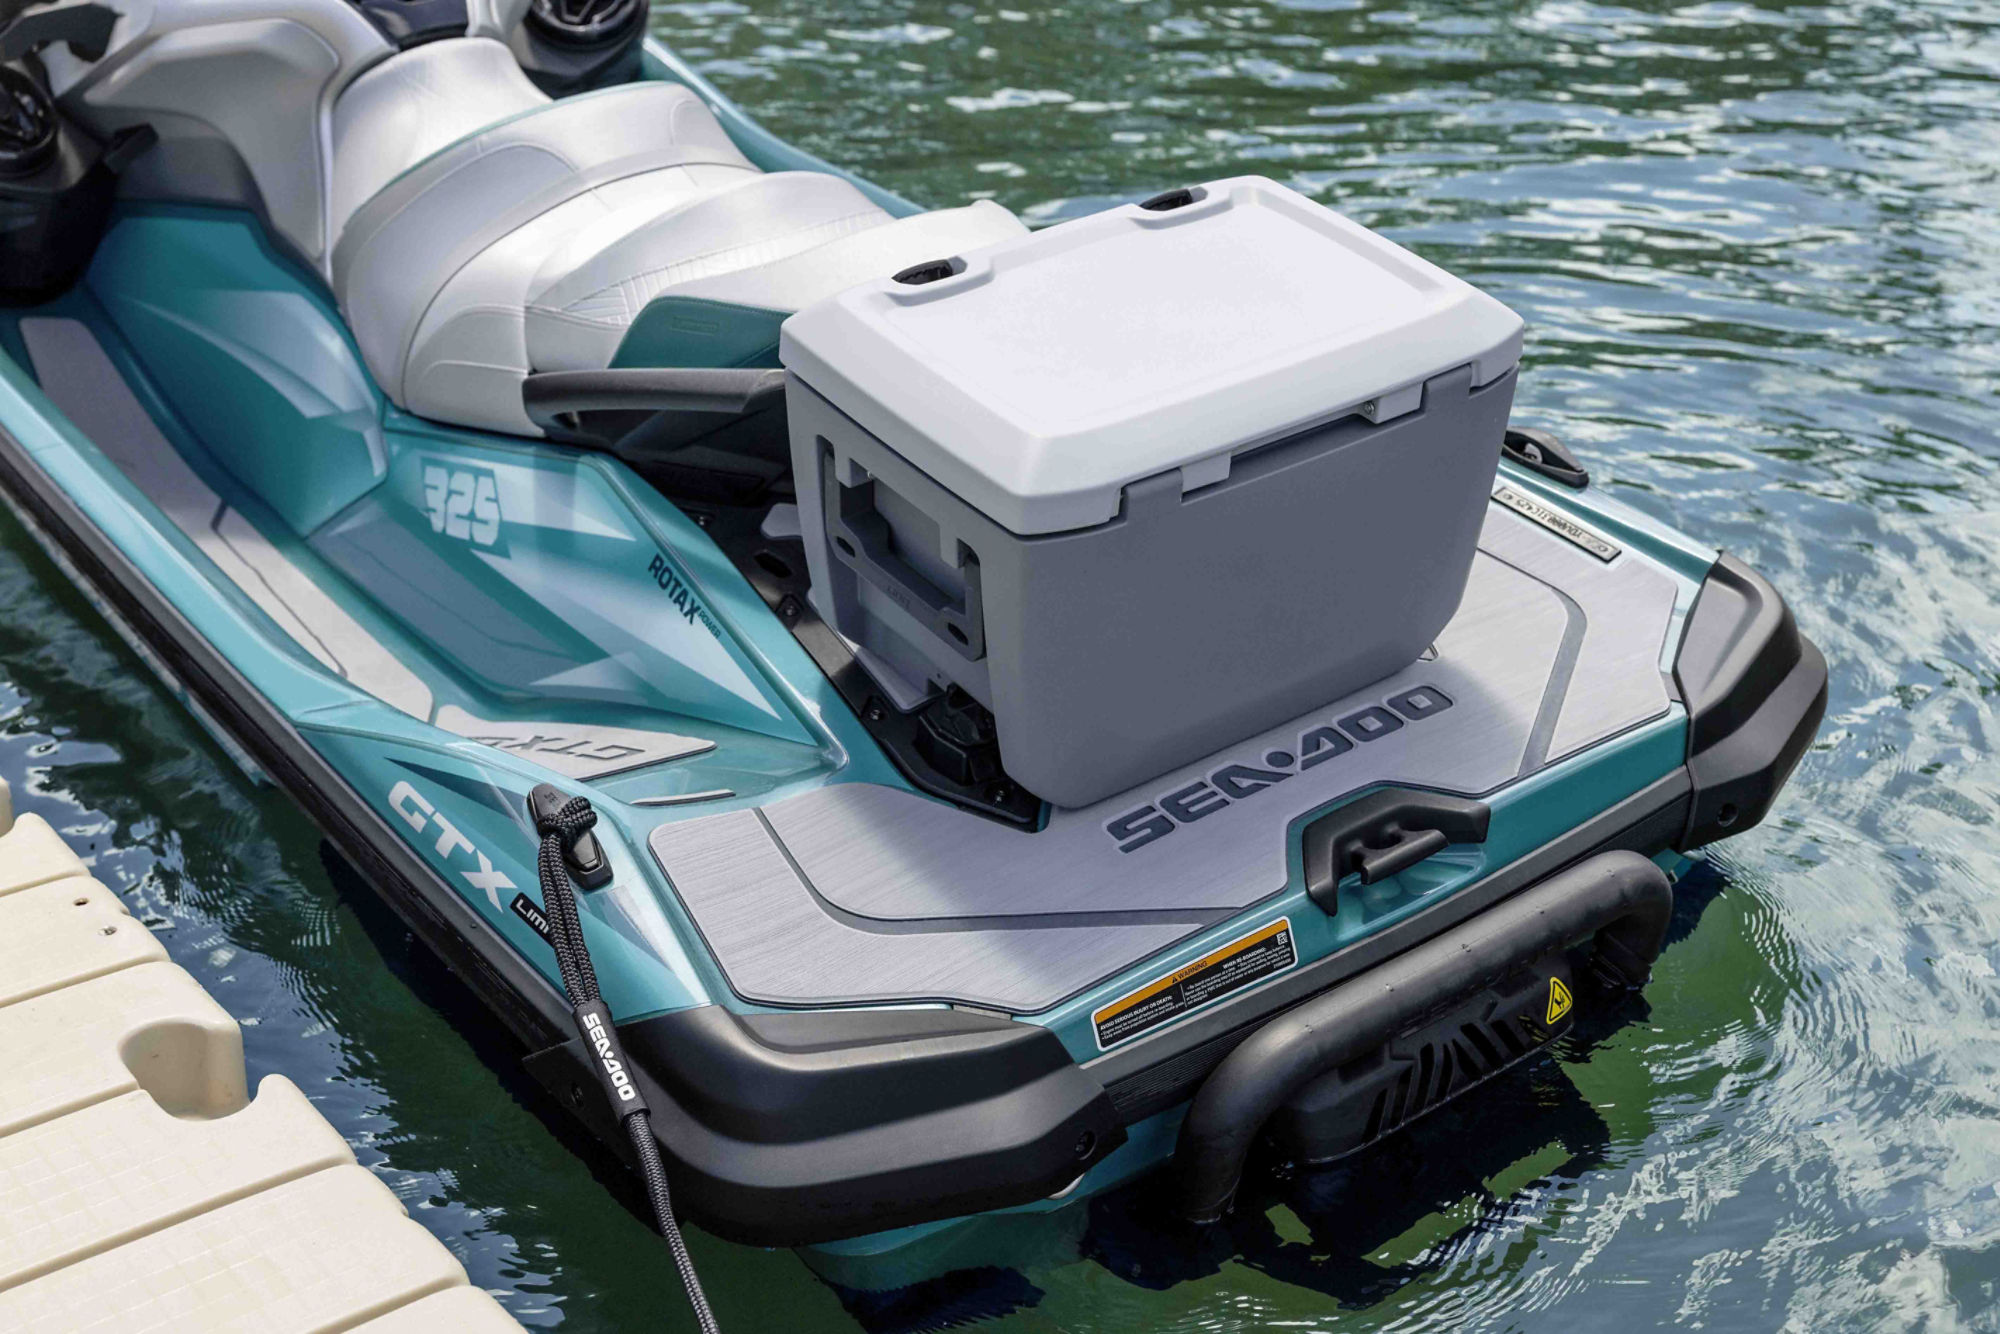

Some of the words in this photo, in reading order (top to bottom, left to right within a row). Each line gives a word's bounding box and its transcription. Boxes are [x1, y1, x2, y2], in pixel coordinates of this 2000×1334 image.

[424, 465, 500, 546] 325
[648, 553, 701, 625] ROTAX
[698, 610, 721, 639] POWER
[388, 781, 518, 913] GTX
[1178, 961, 1208, 980] WARNING
